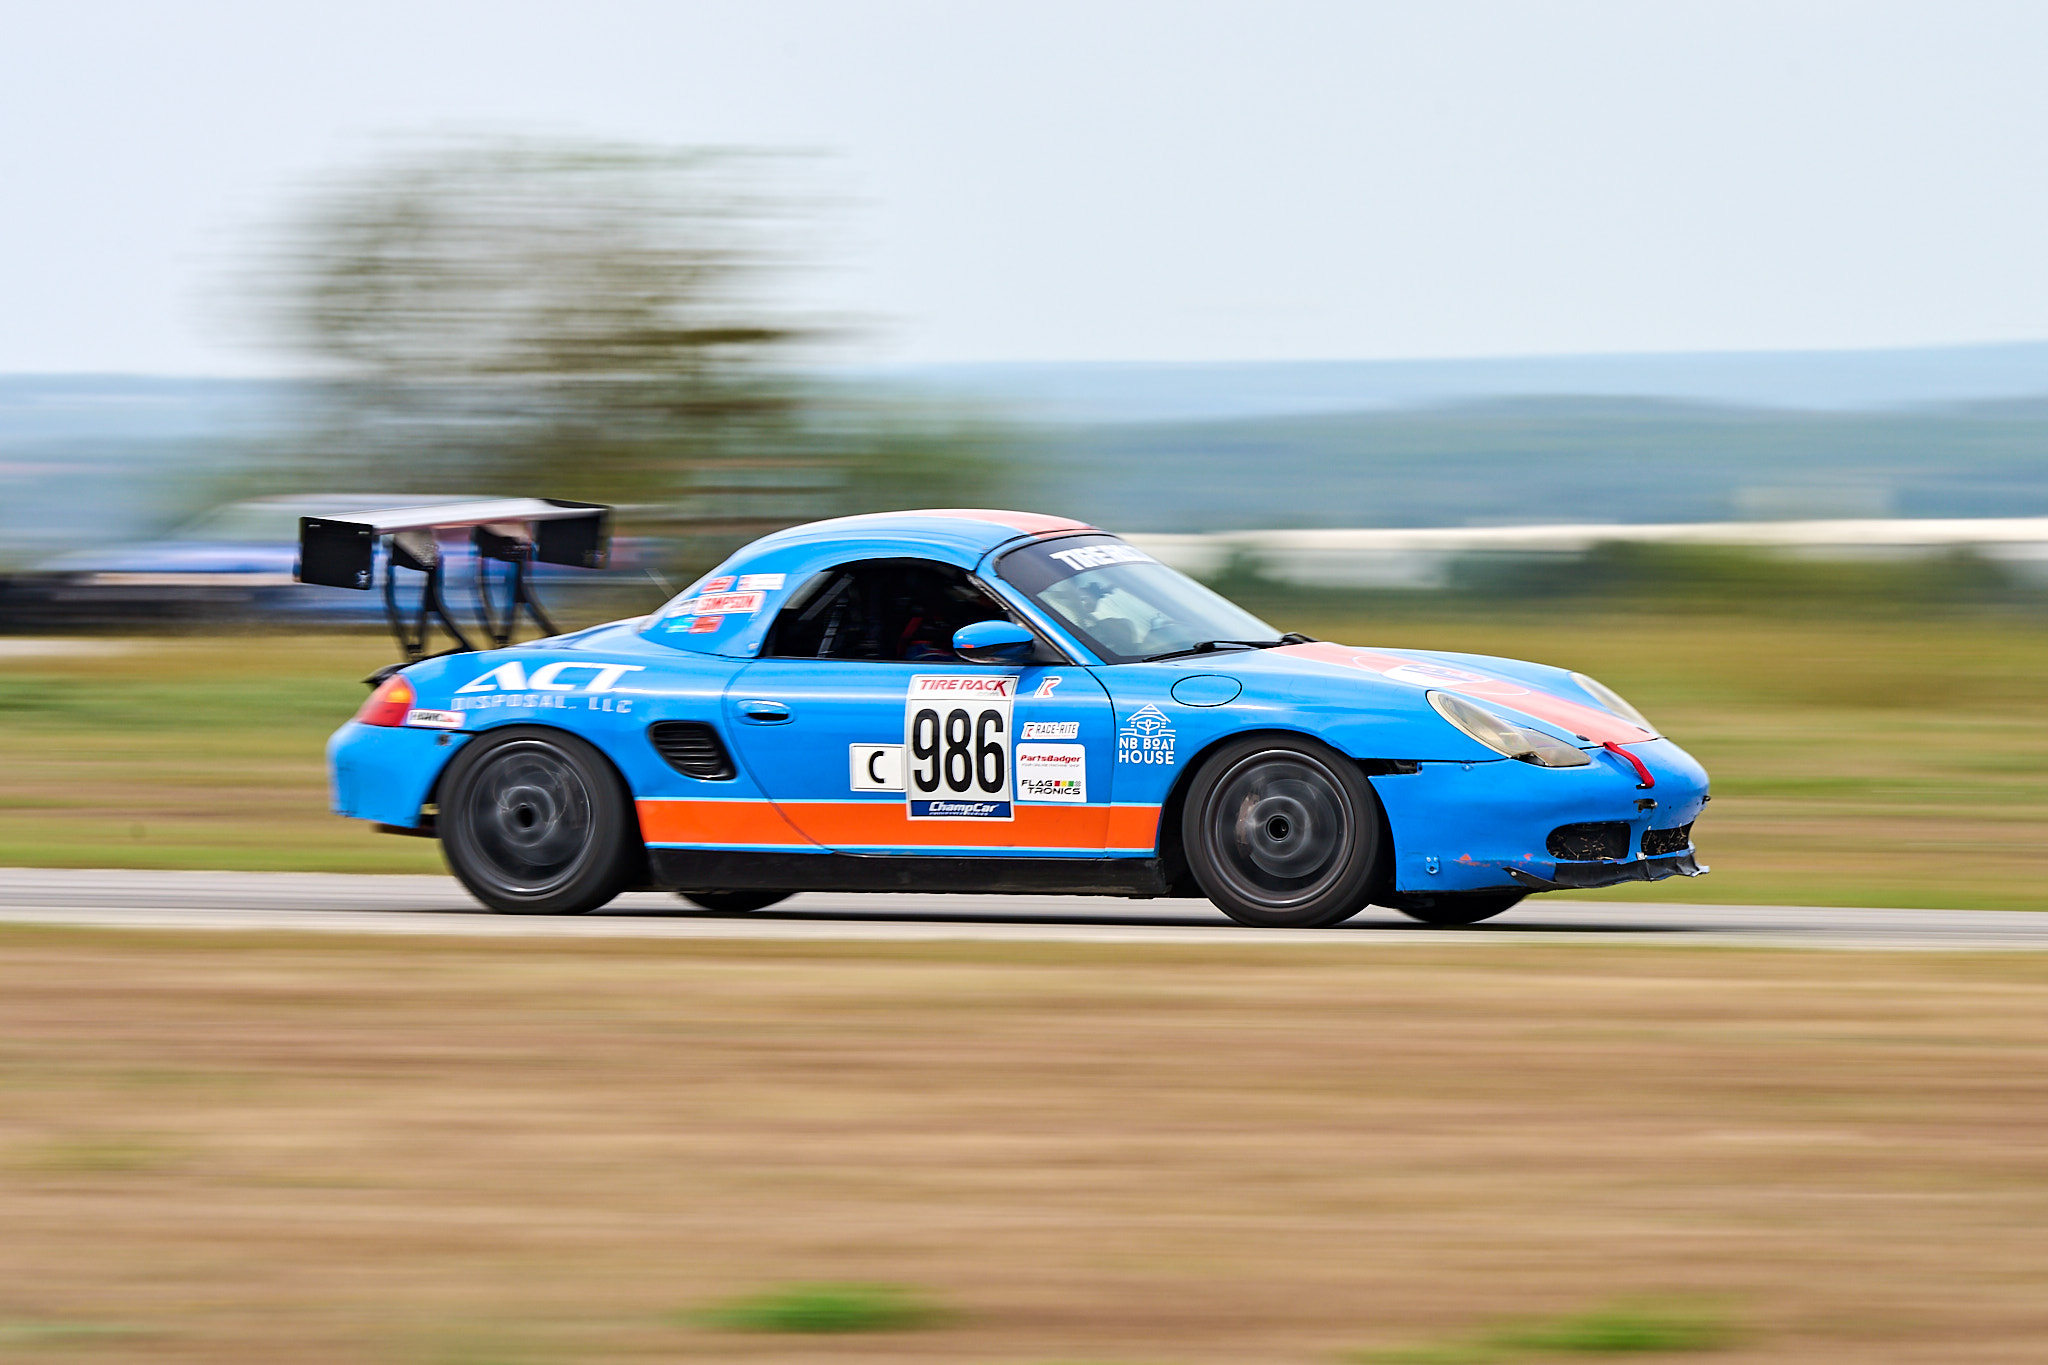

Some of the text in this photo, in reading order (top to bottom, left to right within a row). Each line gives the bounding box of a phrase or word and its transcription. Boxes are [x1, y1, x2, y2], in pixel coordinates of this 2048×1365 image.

[454, 661, 647, 694] ACT
[920, 680, 1006, 697] TIRE RACK
[588, 697, 633, 713] LLC
[1036, 724, 1076, 734] RACE-RITE
[913, 708, 1005, 793] 986
[1119, 737, 1138, 749] NB
[1020, 754, 1082, 764] PartsBadger
[1118, 749, 1175, 765] HOUSE
[869, 750, 885, 783] C
[1027, 787, 1081, 795] TRONICS
[929, 801, 999, 815] ChampCar
